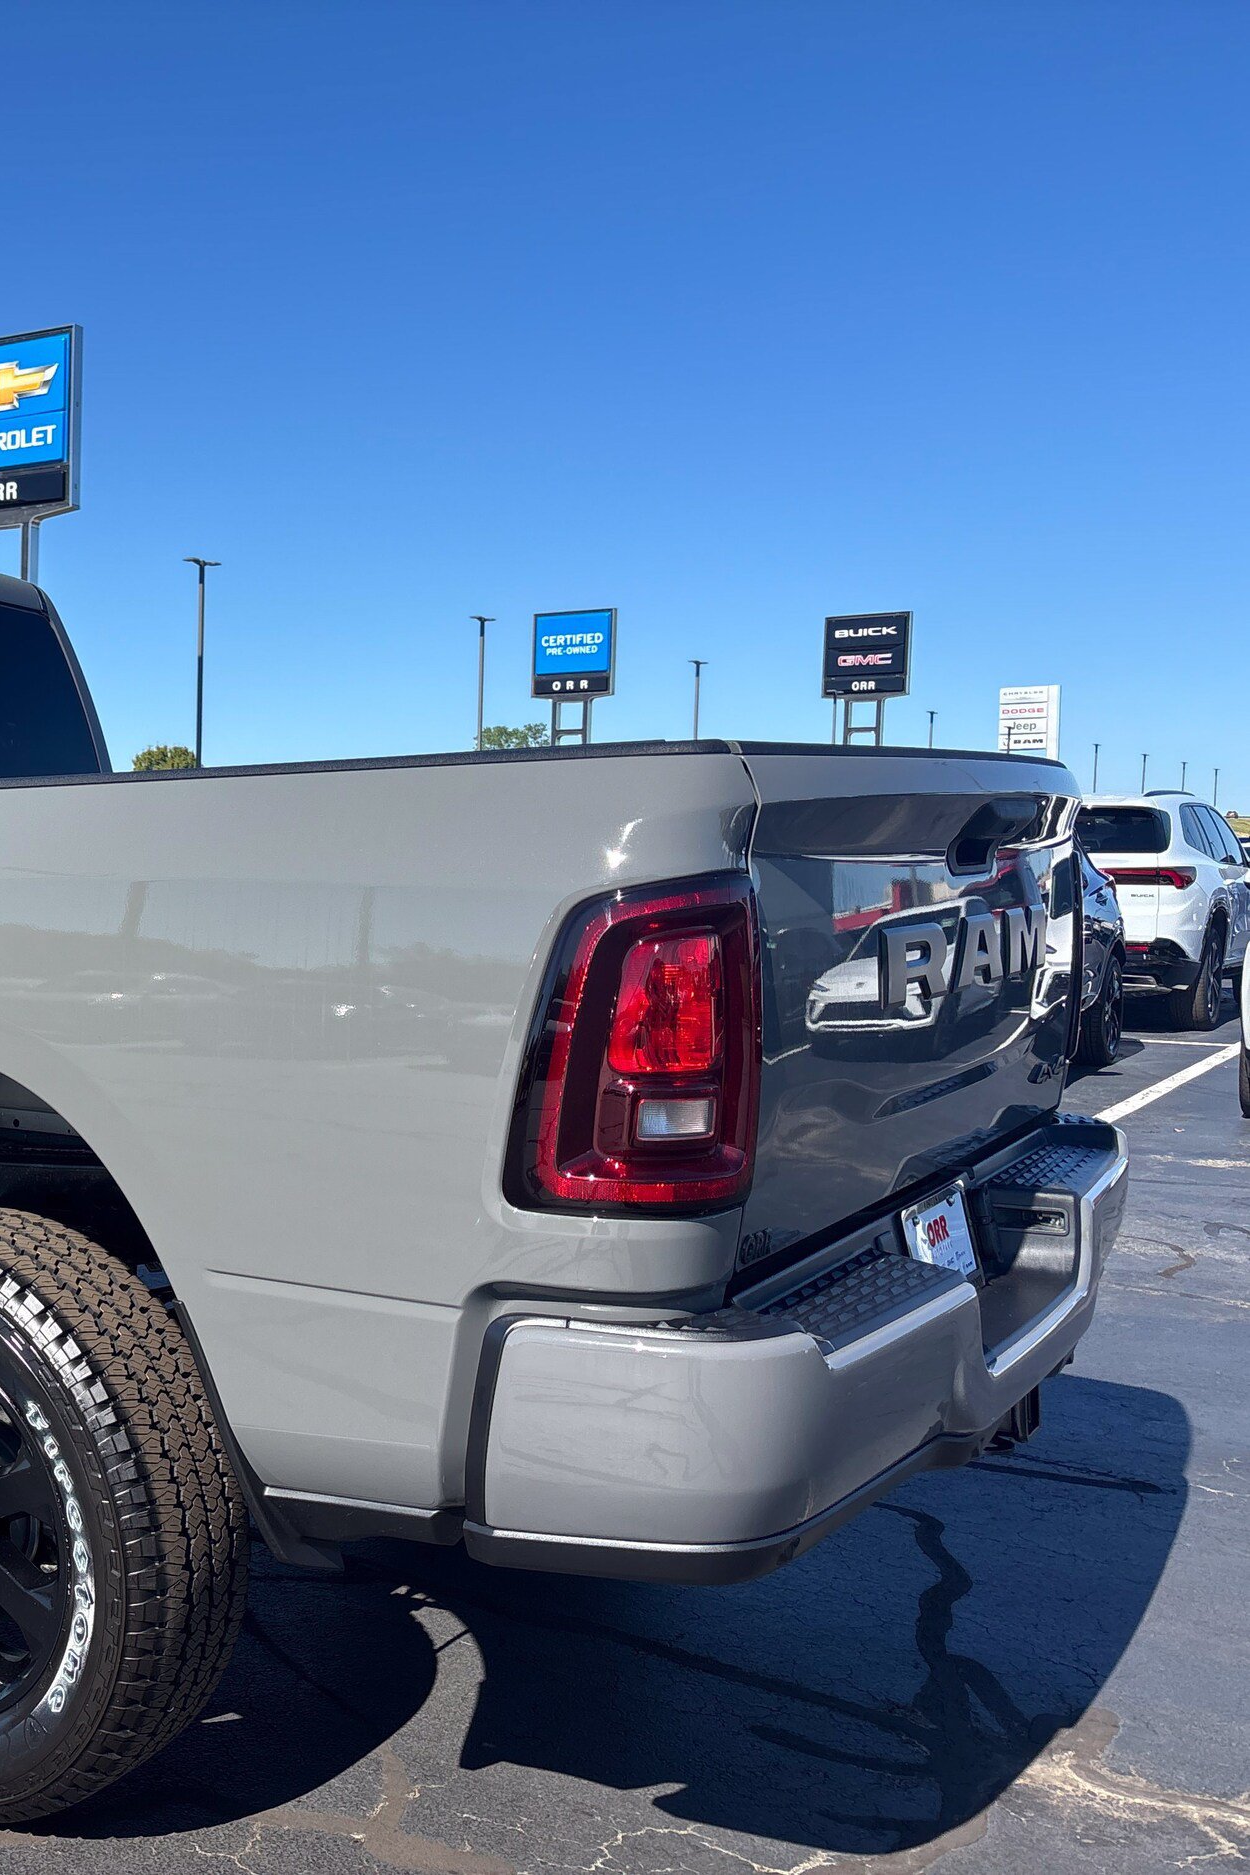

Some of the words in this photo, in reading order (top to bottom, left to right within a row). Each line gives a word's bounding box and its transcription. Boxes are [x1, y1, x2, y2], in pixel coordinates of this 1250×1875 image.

[834, 626, 897, 639] BUICK
[541, 632, 604, 647] CERTIFIED
[546, 645, 598, 656] PRE-OWNED
[837, 652, 893, 667] GMC
[851, 681, 876, 691] ORR
[1002, 707, 1044, 715] DODGE
[1011, 721, 1037, 731] Jeep
[878, 903, 1047, 1009] RAM
[926, 1214, 950, 1248] ORR
